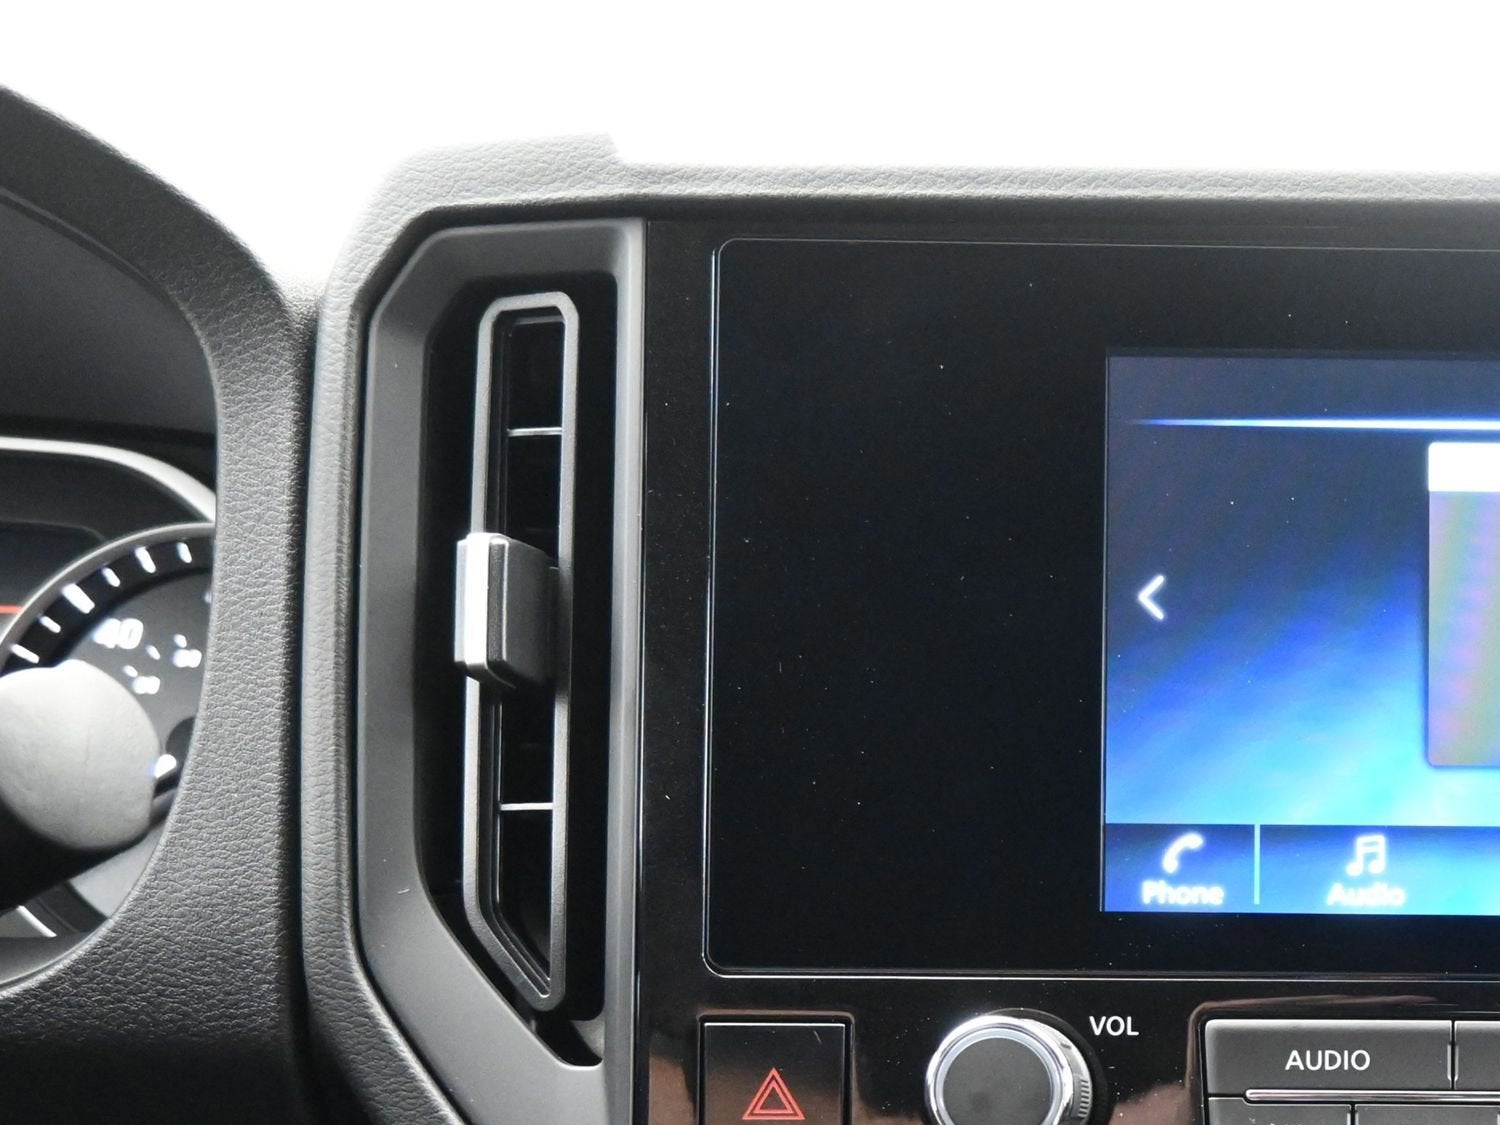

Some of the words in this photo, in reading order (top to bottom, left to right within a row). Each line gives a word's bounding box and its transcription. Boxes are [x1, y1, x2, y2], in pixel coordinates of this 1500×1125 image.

[1141, 881, 1224, 905] Phone
[1327, 881, 1407, 908] Audio
[1089, 1015, 1140, 1036] VOL
[1284, 1049, 1371, 1072] AUDIO
